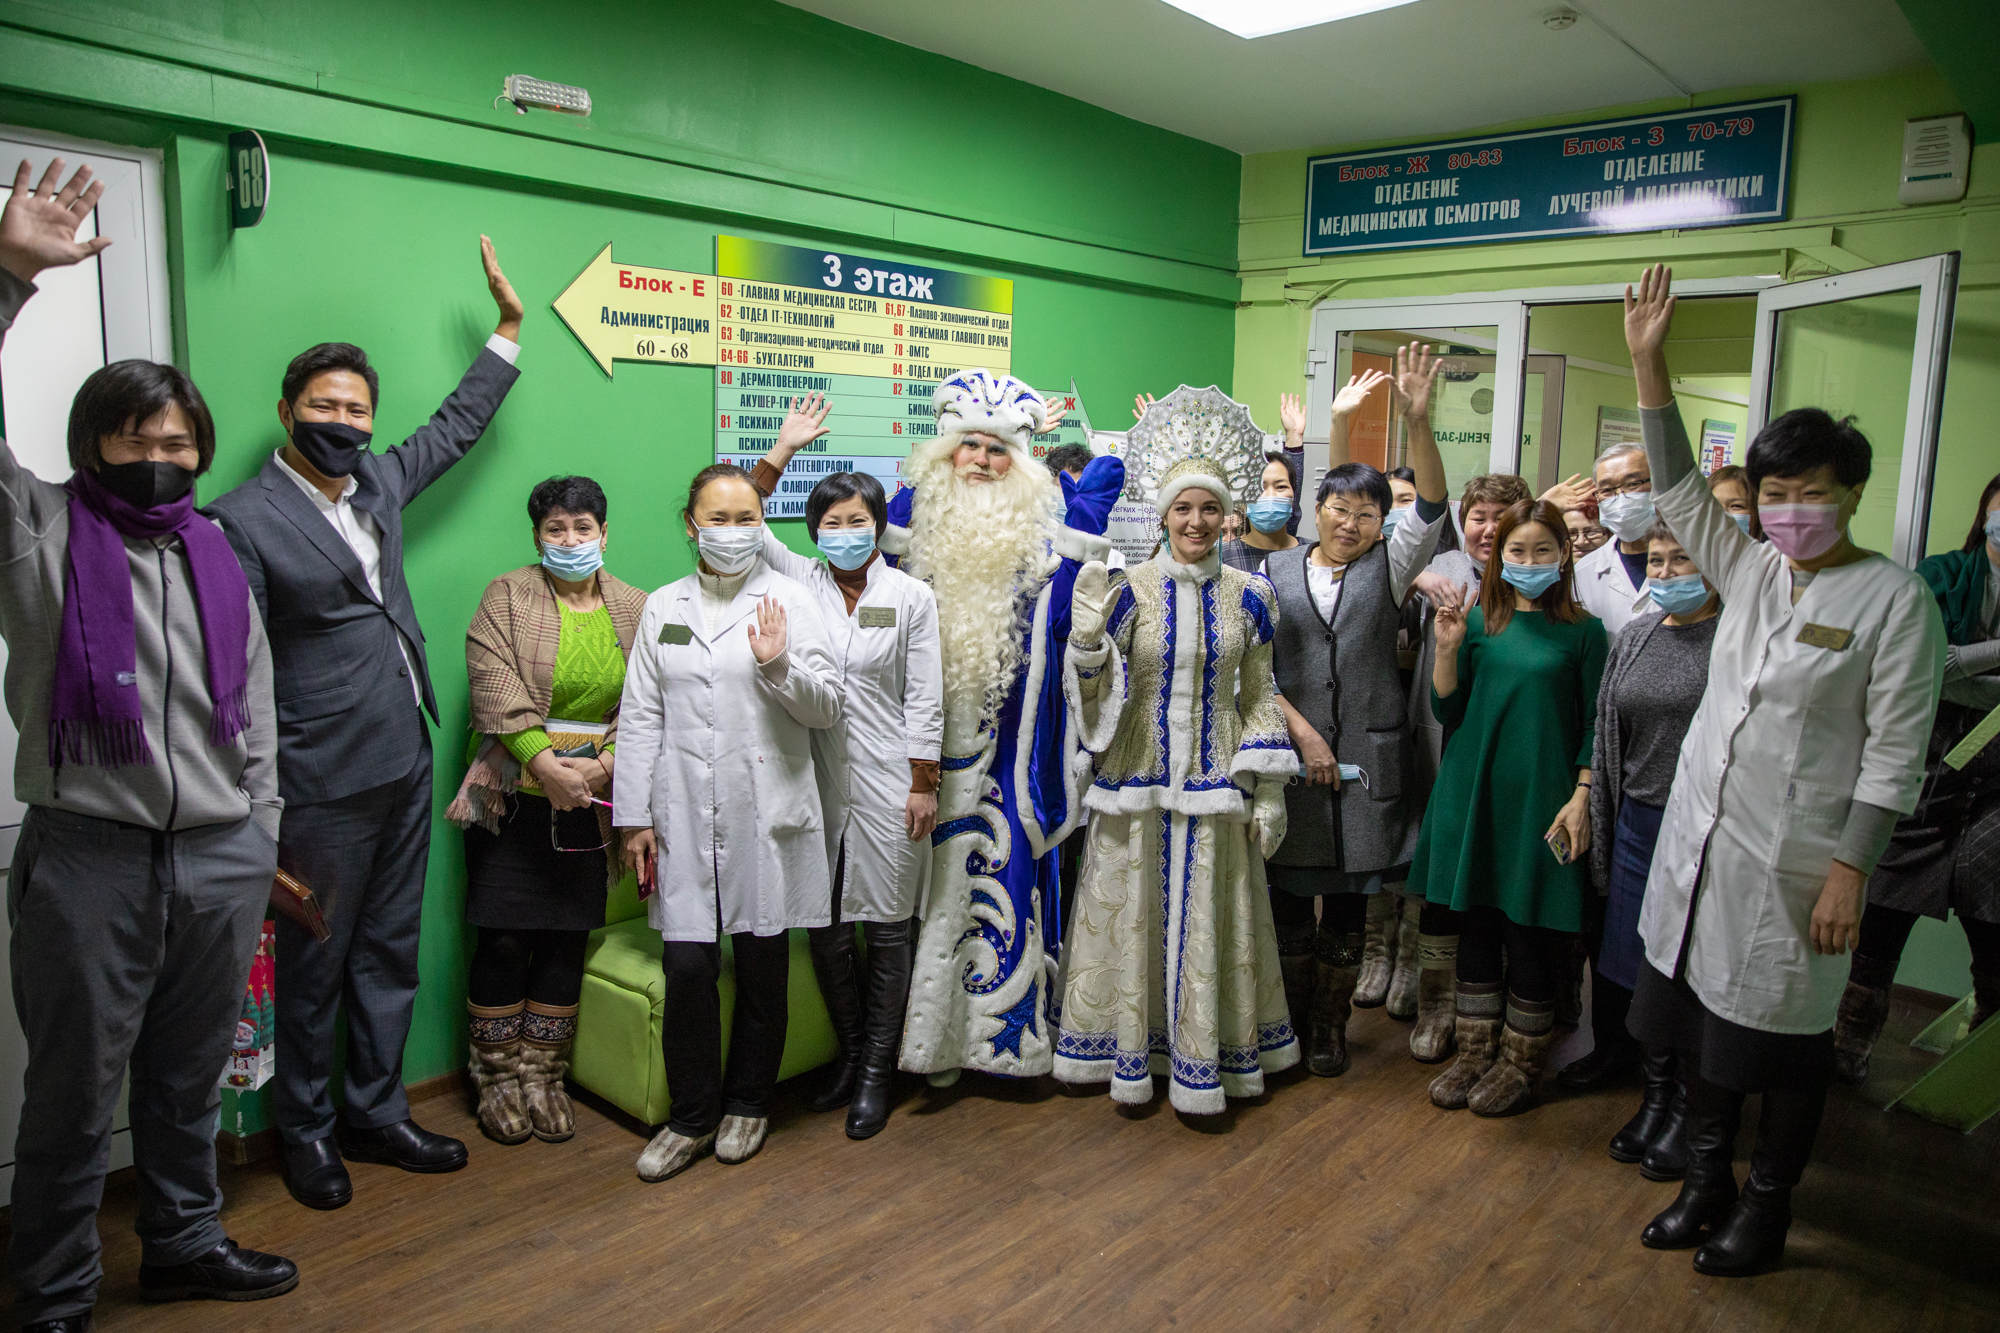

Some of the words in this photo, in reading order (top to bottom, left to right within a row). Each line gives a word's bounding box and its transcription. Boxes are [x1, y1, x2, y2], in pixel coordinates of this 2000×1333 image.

[1563, 136, 1625, 156] Блок
[1687, 117, 1754, 142] 70-79
[238, 146, 264, 209] 68
[1339, 164, 1389, 182] Блок
[1406, 155, 1430, 174] Ж
[1447, 149, 1503, 170] 80-83
[1603, 150, 1705, 182] ОТДЕЛЕНИЕ
[1375, 177, 1460, 205] ОТДЕЛЕНИЕ
[1548, 186, 1625, 216] ЛУЧЕВОЙ
[1632, 175, 1764, 211] ДИАГНОСТИКИ
[1318, 208, 1428, 236] МЕДИЦИНСКИХ
[1434, 199, 1521, 226] ОСМОТРОВ
[619, 270, 673, 293] Блок
[693, 279, 705, 297] Е
[822, 254, 842, 287] 3
[853, 267, 934, 300] этаж
[720, 304, 732, 318] 62
[721, 282, 733, 296] 60
[783, 289, 845, 310] МЕДИЦИНСКАЯ
[848, 298, 877, 313] СЕСТРА
[601, 306, 709, 334] Администрация
[885, 302, 906, 317] 61,67
[991, 318, 1009, 330] отдел
[721, 326, 732, 340] 63
[863, 342, 884, 355] отдел
[893, 323, 903, 336] 68
[951, 330, 985, 345] ГЛАВНОГО
[988, 335, 1008, 348] ВРАЧА
[637, 340, 655, 356] 60
[671, 342, 688, 359] 68
[721, 348, 749, 364] 64-66
[894, 343, 903, 356] 78
[721, 371, 732, 384] 80
[893, 363, 903, 376] 84
[893, 383, 902, 395] 82
[1064, 397, 1076, 410] Ж
[721, 415, 730, 428] 81
[893, 422, 902, 435] 85
